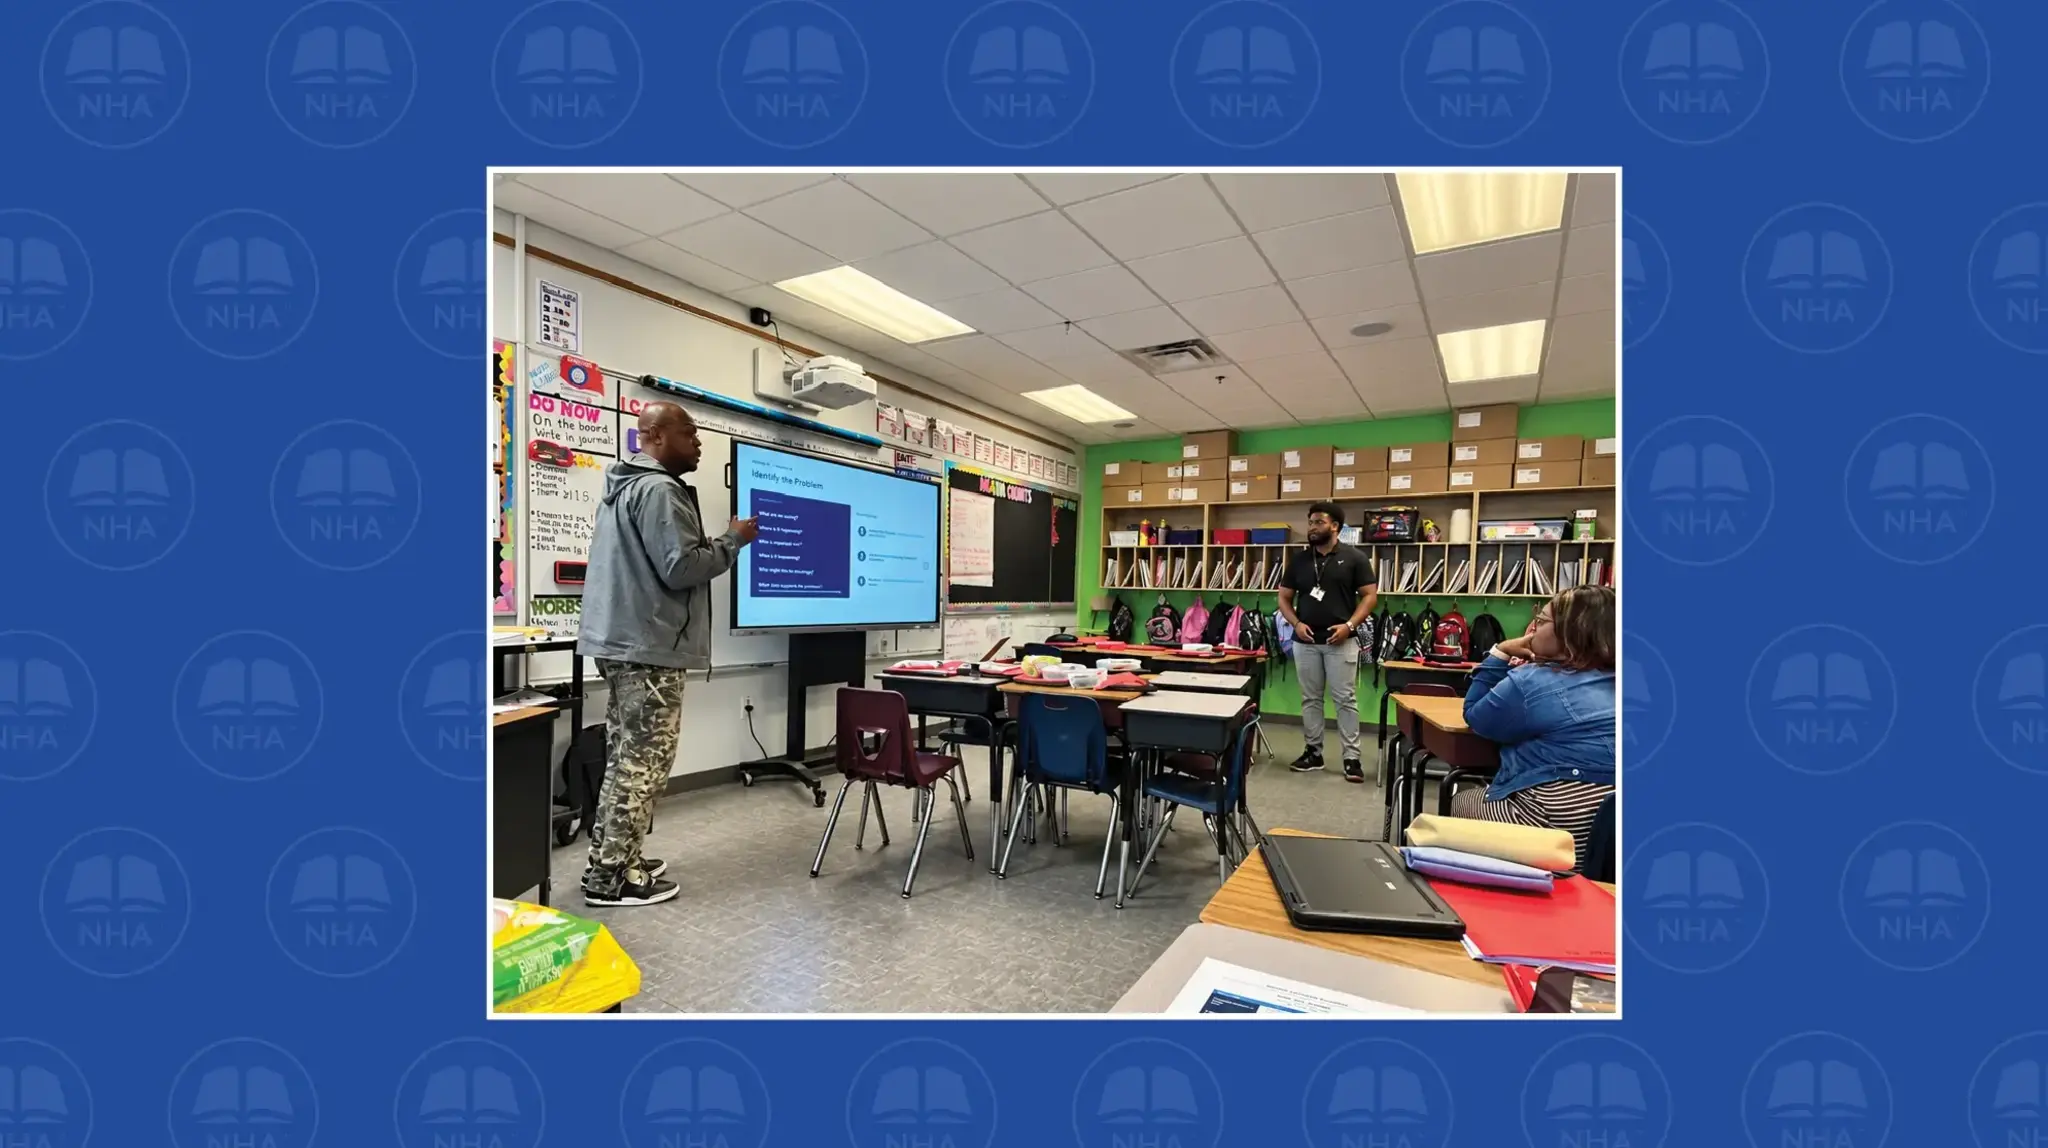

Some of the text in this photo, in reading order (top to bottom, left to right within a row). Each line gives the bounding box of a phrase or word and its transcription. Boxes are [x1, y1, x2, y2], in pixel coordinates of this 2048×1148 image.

[529, 393, 601, 423] DO NOW
[532, 413, 552, 426] On
[558, 418, 575, 430] the
[566, 431, 575, 442] in
[751, 469, 824, 490] Identify the Problem
